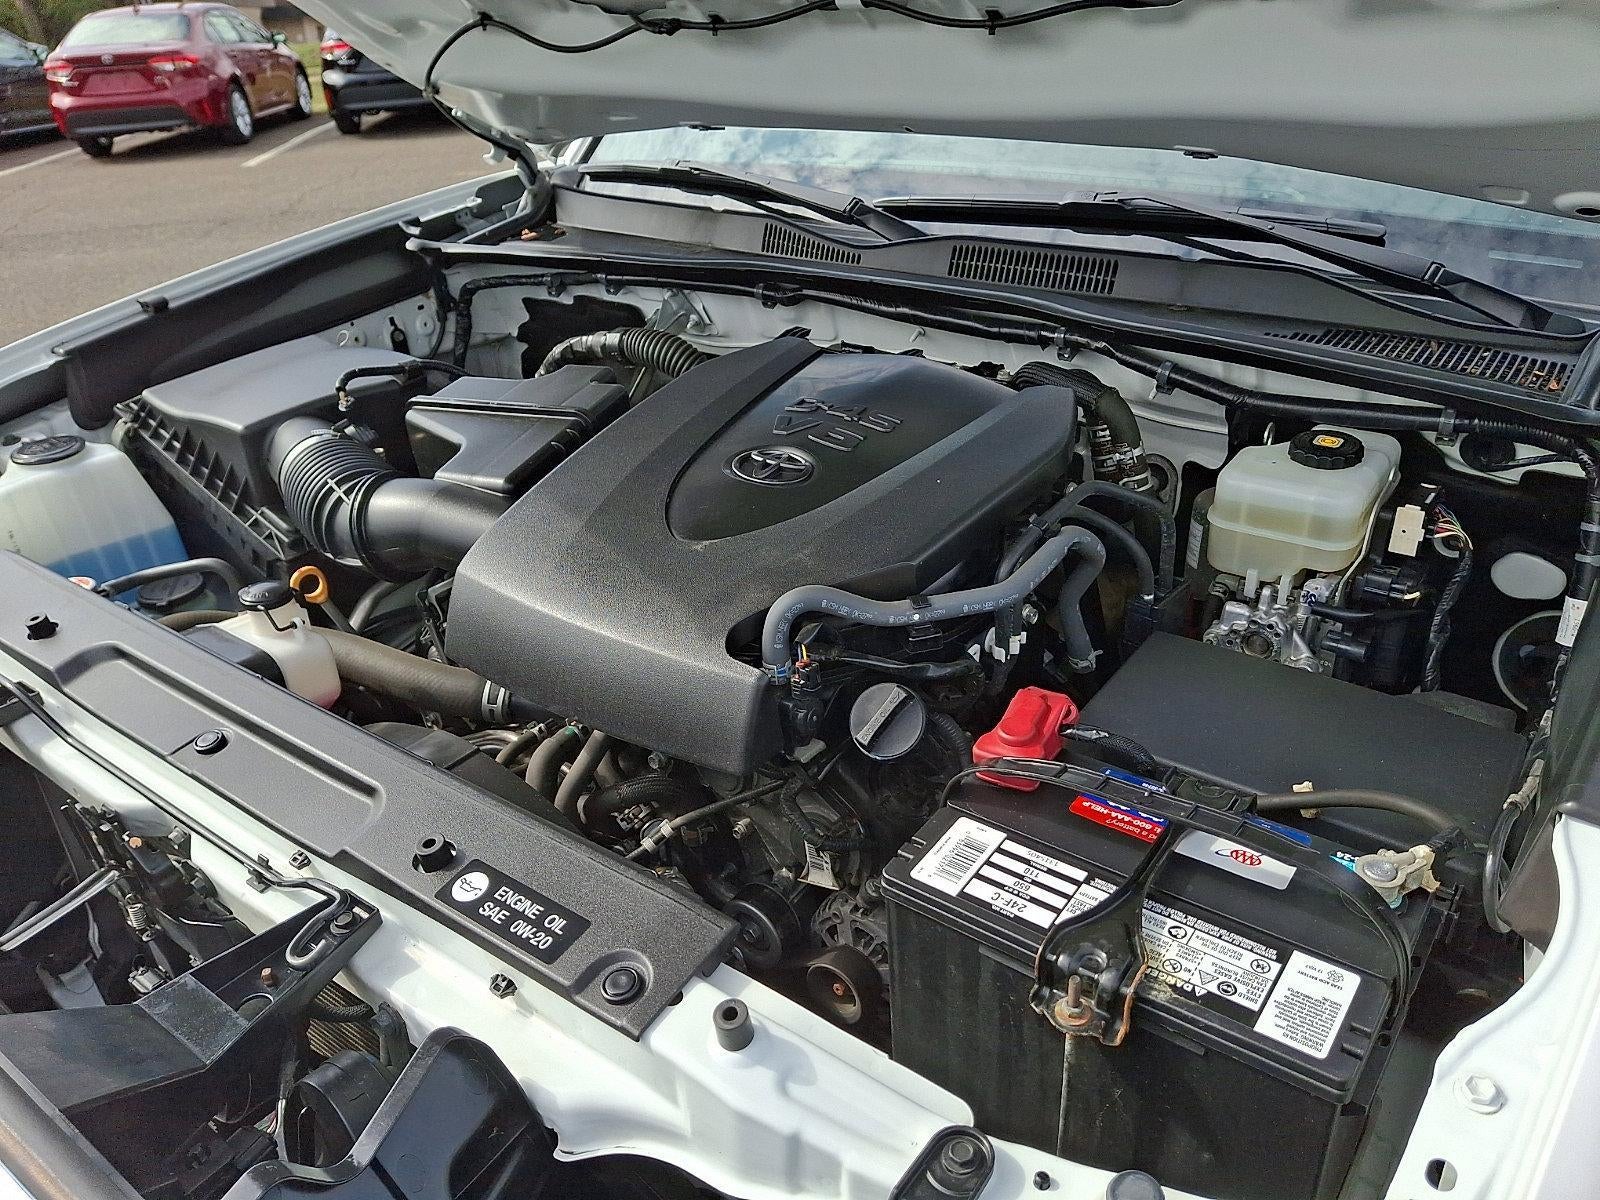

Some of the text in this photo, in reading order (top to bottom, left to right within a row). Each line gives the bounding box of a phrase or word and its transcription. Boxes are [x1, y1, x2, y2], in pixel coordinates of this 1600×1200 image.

[772, 415, 867, 452] V6
[1106, 819, 1140, 833] battery?
[1230, 849, 1261, 866] AAA
[1023, 868, 1039, 878] 110
[1013, 881, 1031, 891] 650
[991, 892, 1027, 912] 24F-C
[494, 886, 568, 936] ENGINE OIL
[478, 901, 554, 950] SAE 0W-20
[1236, 991, 1259, 1004] SHIELD
